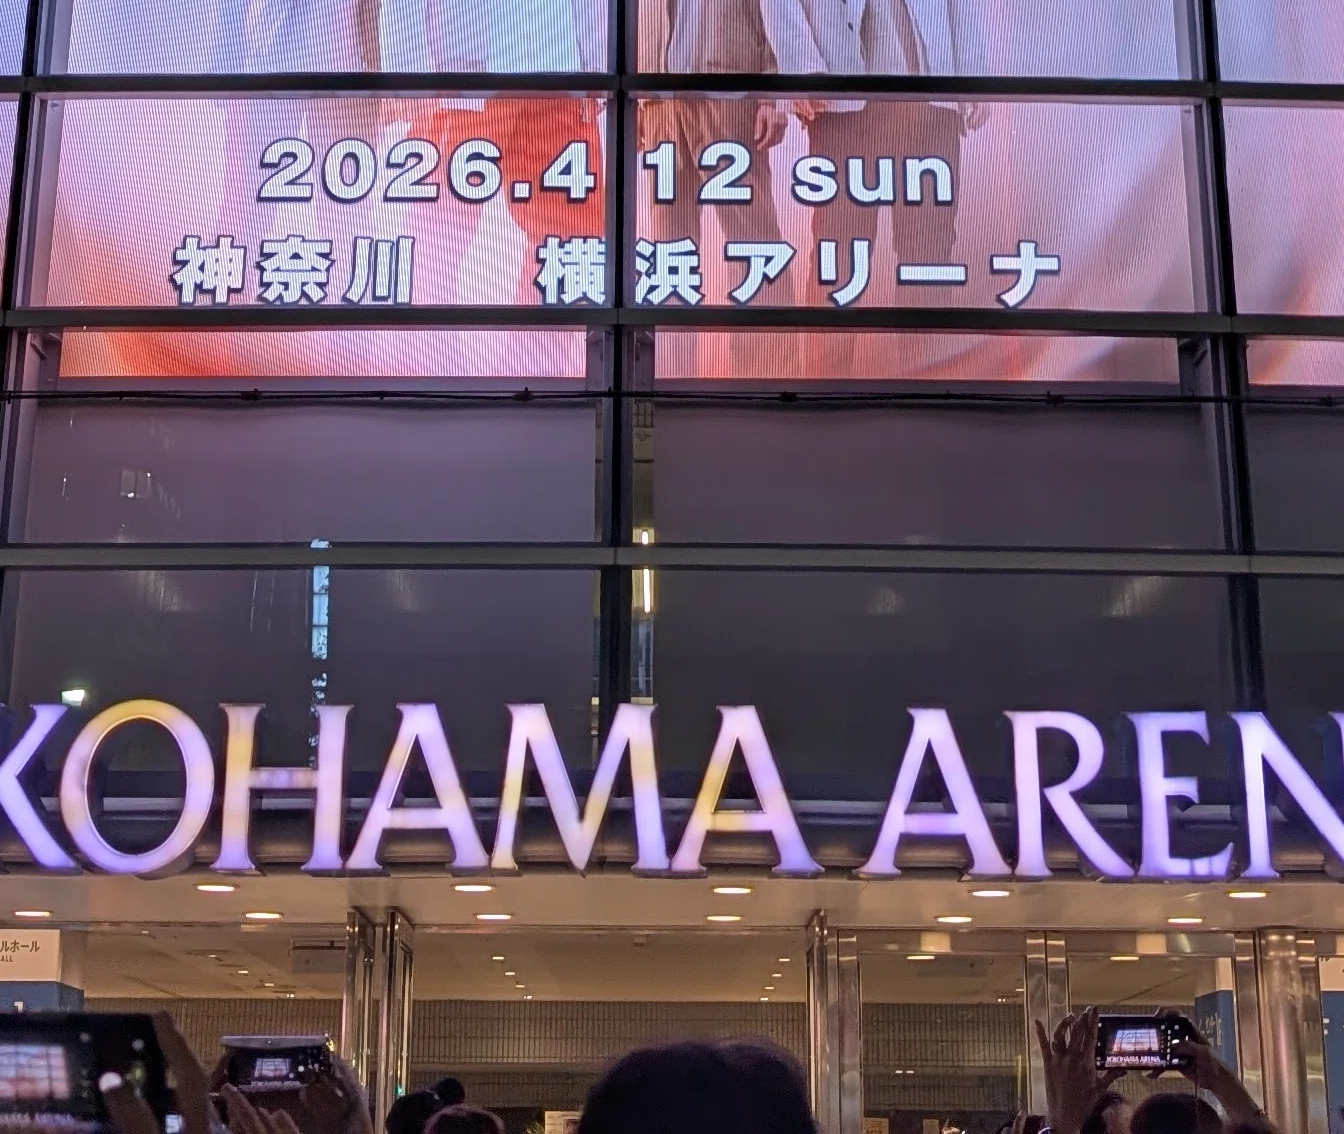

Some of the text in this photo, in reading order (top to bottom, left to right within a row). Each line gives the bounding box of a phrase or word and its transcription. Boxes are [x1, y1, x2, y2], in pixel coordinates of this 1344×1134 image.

[792, 154, 954, 205] sun
[169, 234, 1062, 309] 神奈川 横浜アリーナ
